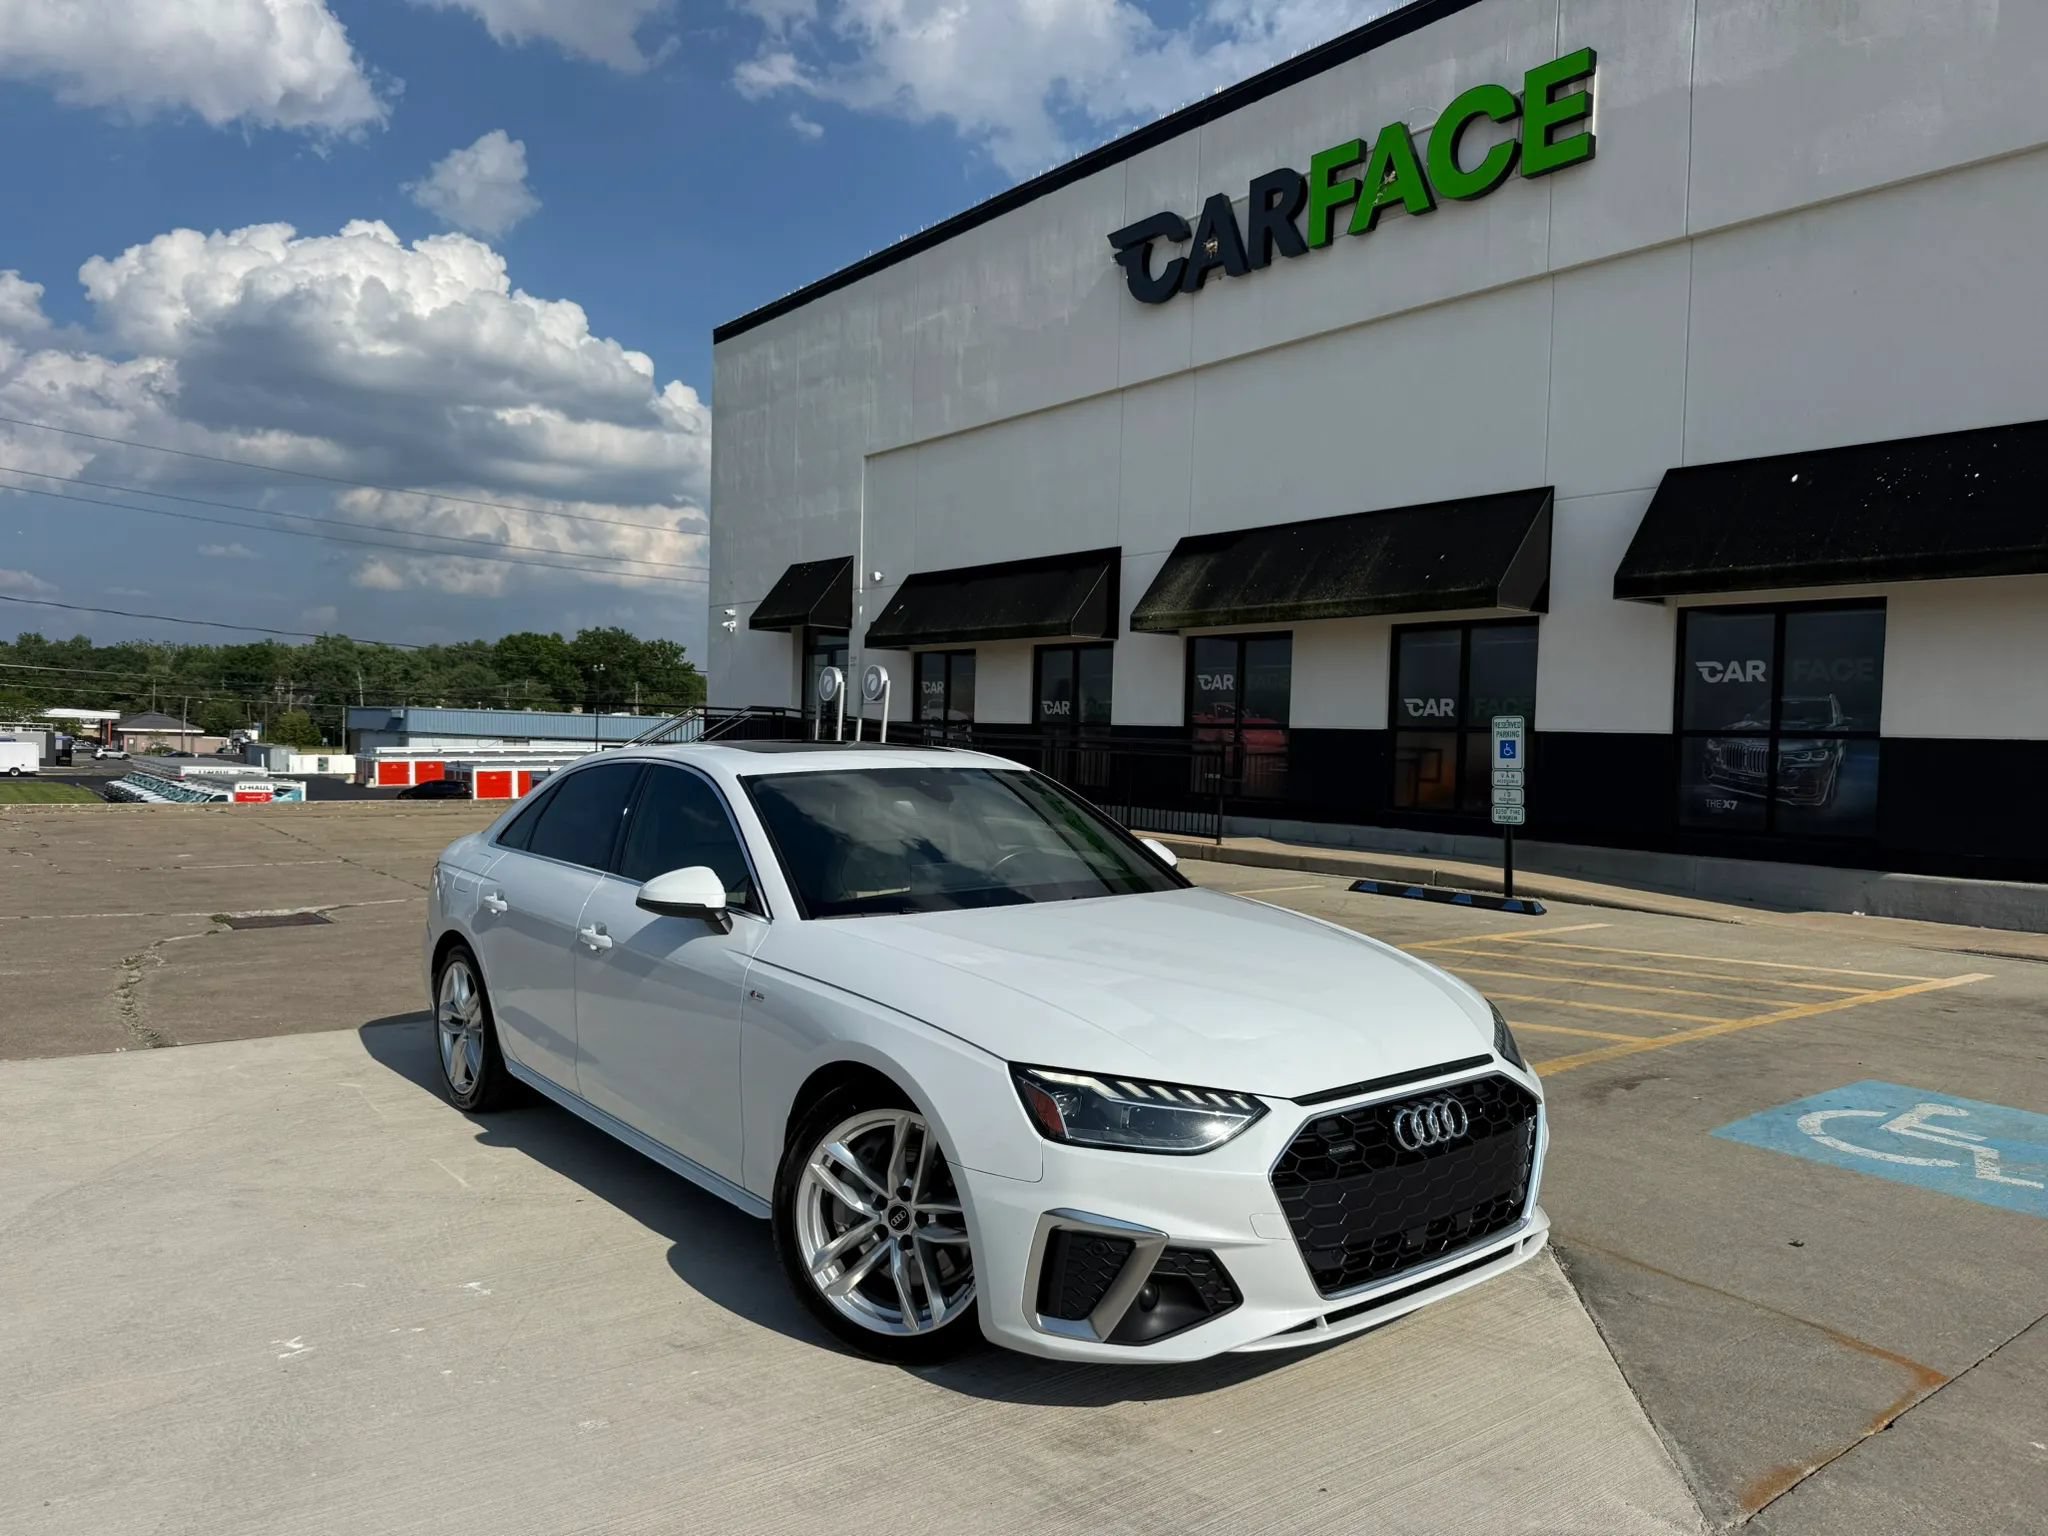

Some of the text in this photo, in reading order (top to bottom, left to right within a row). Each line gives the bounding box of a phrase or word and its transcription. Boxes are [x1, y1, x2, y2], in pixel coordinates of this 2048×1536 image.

[1696, 657, 1875, 684] CAR FACE
[922, 681, 945, 694] CAR
[1196, 674, 1235, 691] CAR
[1042, 700, 1072, 715] CAR
[1403, 697, 1456, 717] CAR
[1495, 721, 1521, 729] RESERVED
[1495, 730, 1520, 738] PARKING
[1705, 799, 1738, 810] THE X7
